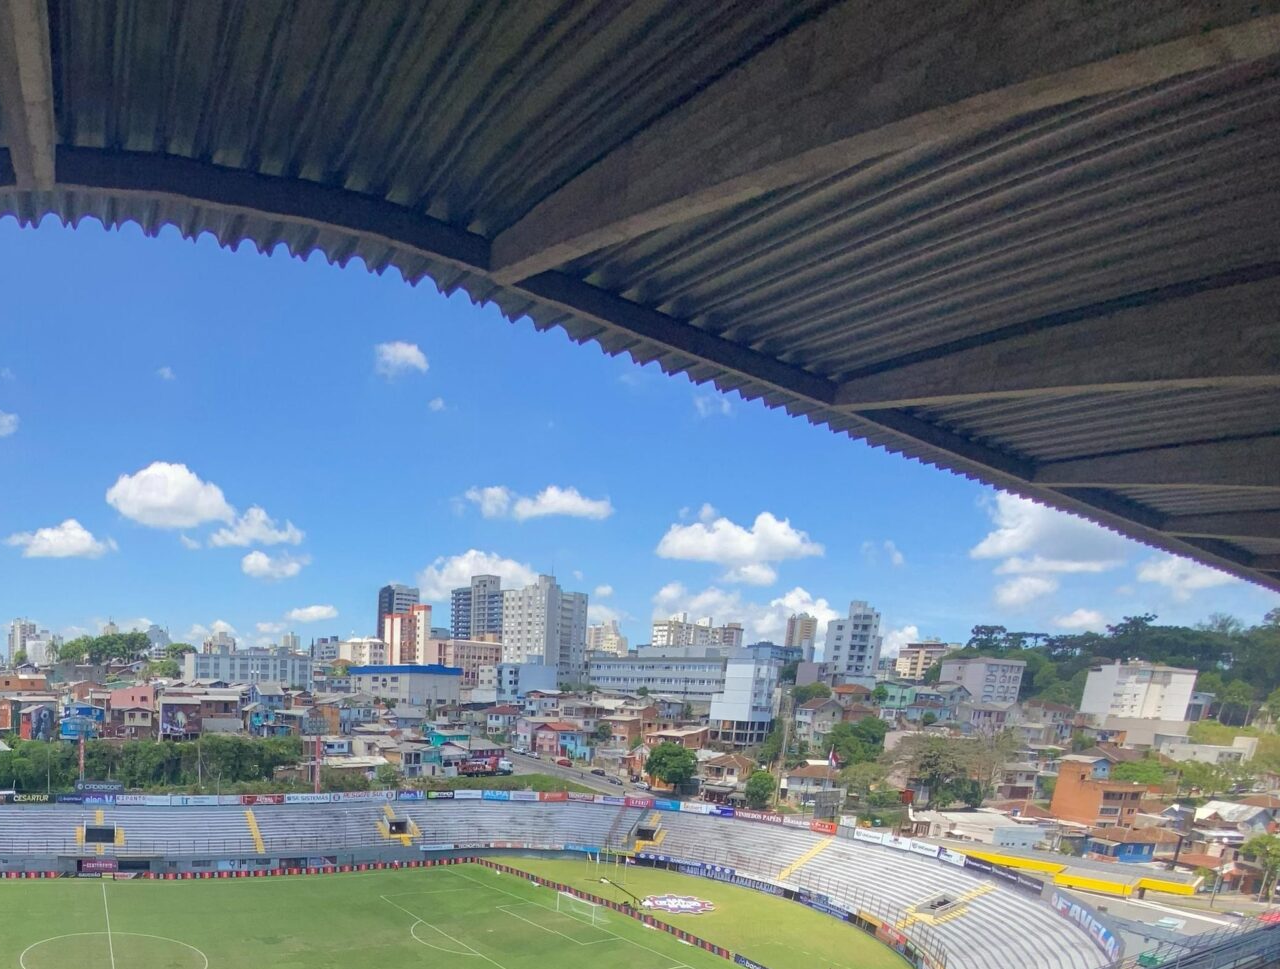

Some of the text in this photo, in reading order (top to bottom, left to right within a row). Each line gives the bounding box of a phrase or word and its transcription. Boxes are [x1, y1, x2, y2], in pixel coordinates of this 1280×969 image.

[13, 794, 50, 802] CESARTUR
[735, 810, 762, 821] VINHEDOS
[1057, 896, 1116, 957] FAVELA
